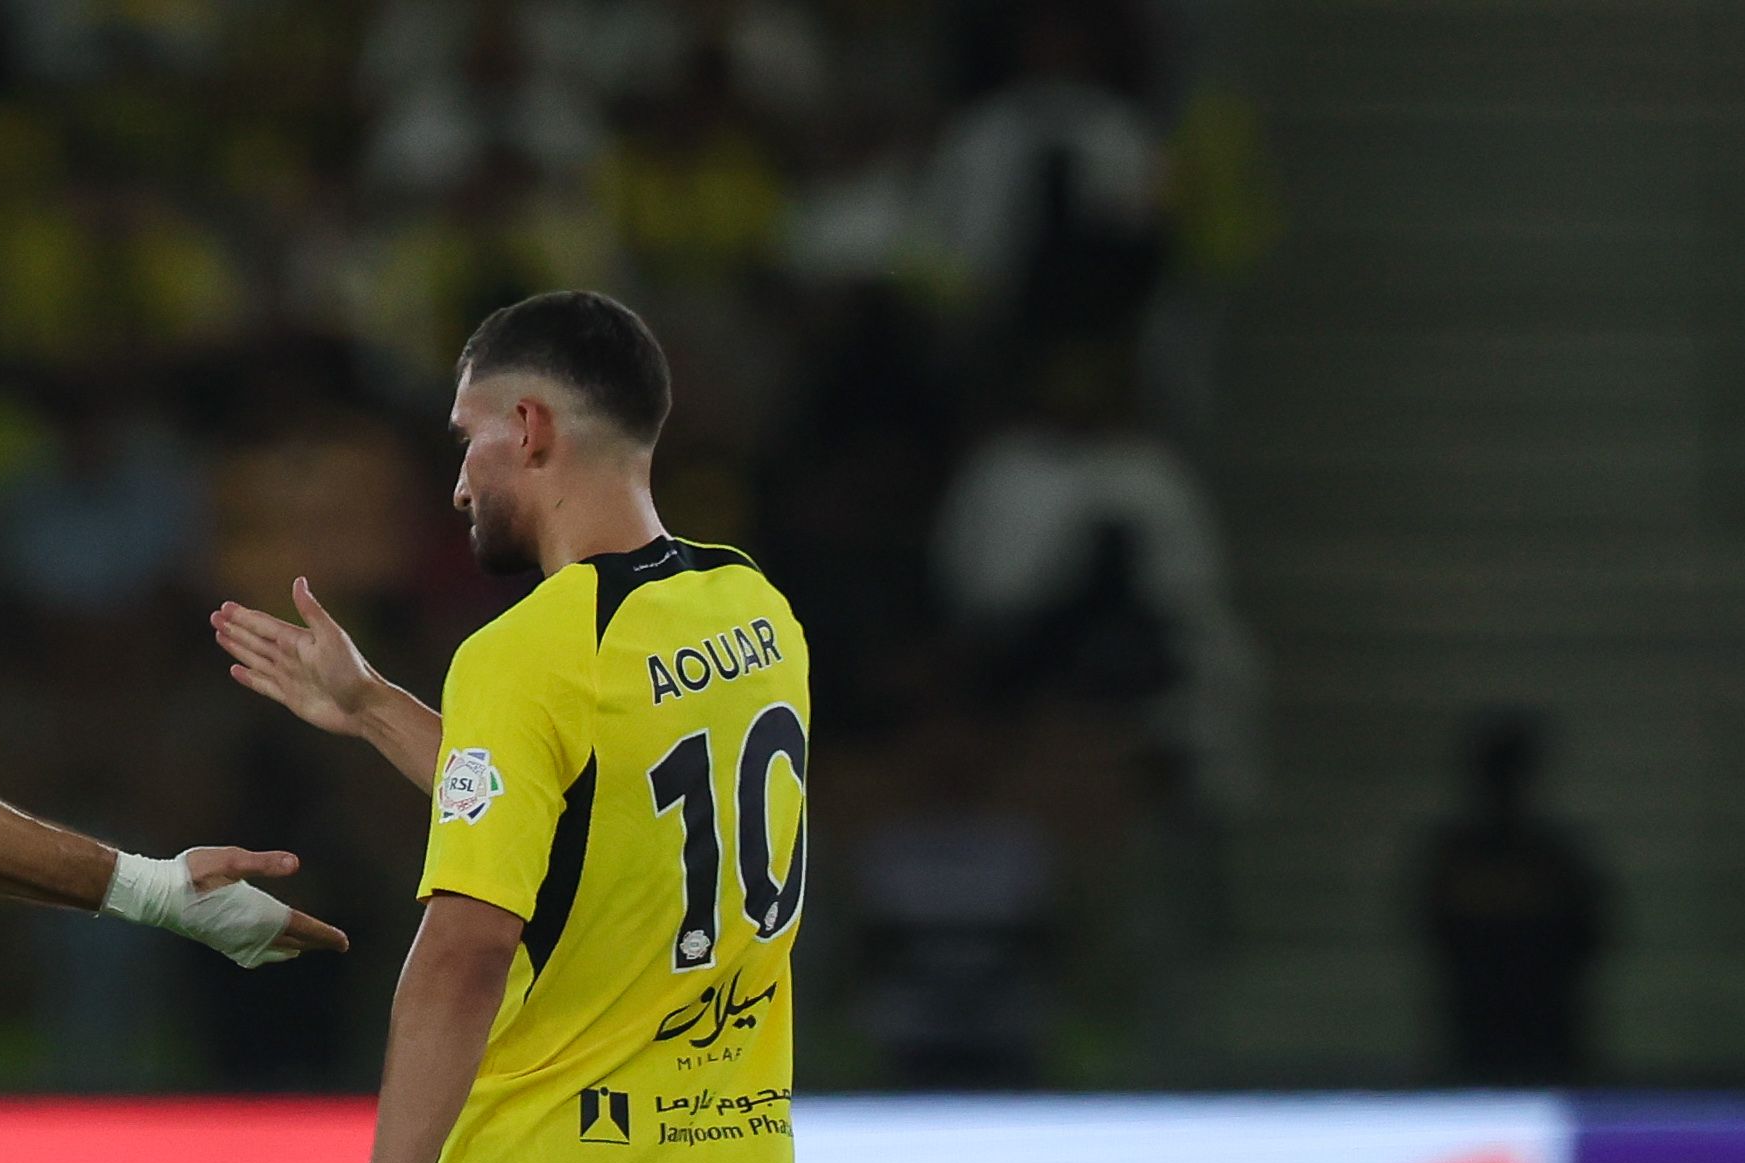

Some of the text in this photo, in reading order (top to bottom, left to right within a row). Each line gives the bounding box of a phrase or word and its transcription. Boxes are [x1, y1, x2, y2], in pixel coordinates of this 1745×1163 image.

[647, 617, 783, 705] AOUAR
[449, 777, 475, 793] RSL
[646, 701, 807, 974] 10
[716, 1088, 792, 1116] مجوم
